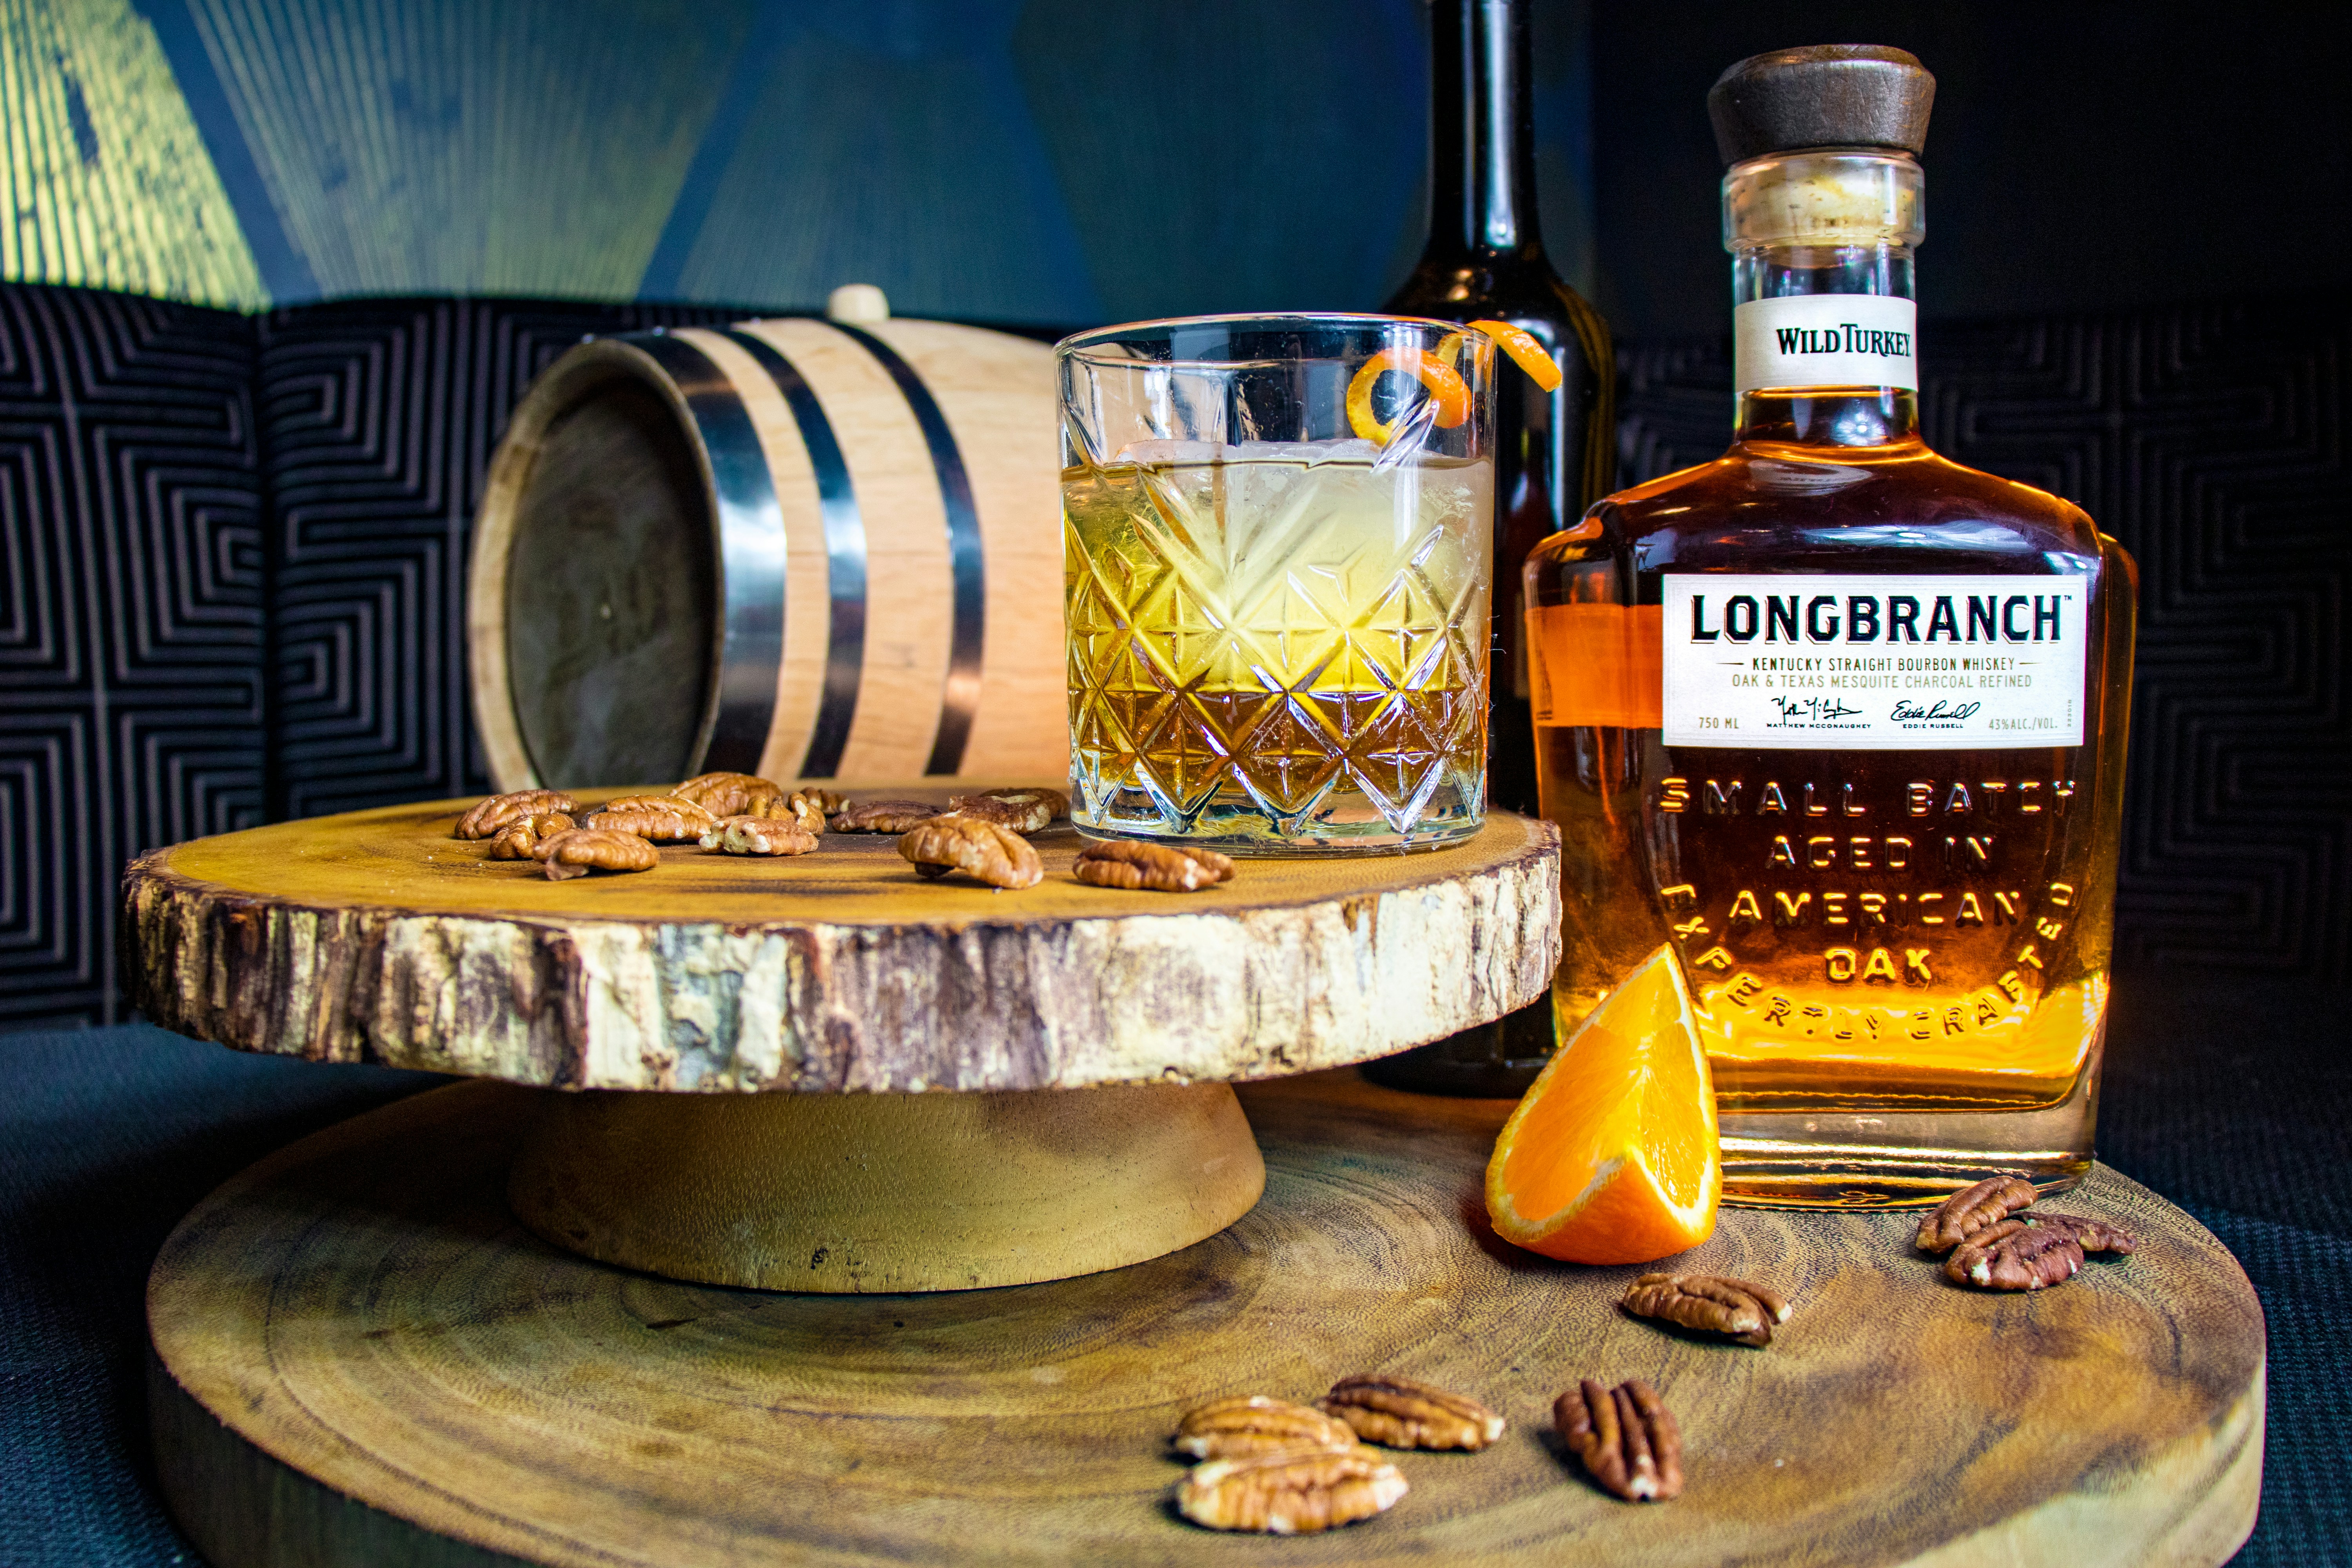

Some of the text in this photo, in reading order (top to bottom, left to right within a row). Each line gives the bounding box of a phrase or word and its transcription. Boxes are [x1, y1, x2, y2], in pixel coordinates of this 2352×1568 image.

[1690, 595, 2062, 645] LONGBRANCH
[1732, 674, 2032, 688] OAK & TEXAS MESQUITE CHARCOAL REFINED
[1753, 657, 2014, 671] KENTUCKY STRAIGHT BOURBON WHISKEY
[1699, 717, 1739, 729] 750 ML
[1661, 778, 2075, 817] SMALL BATCH
[1766, 835, 1993, 871] AGED IN
[1729, 890, 2021, 927] AMERICAN
[1824, 947, 1933, 986] OAK
